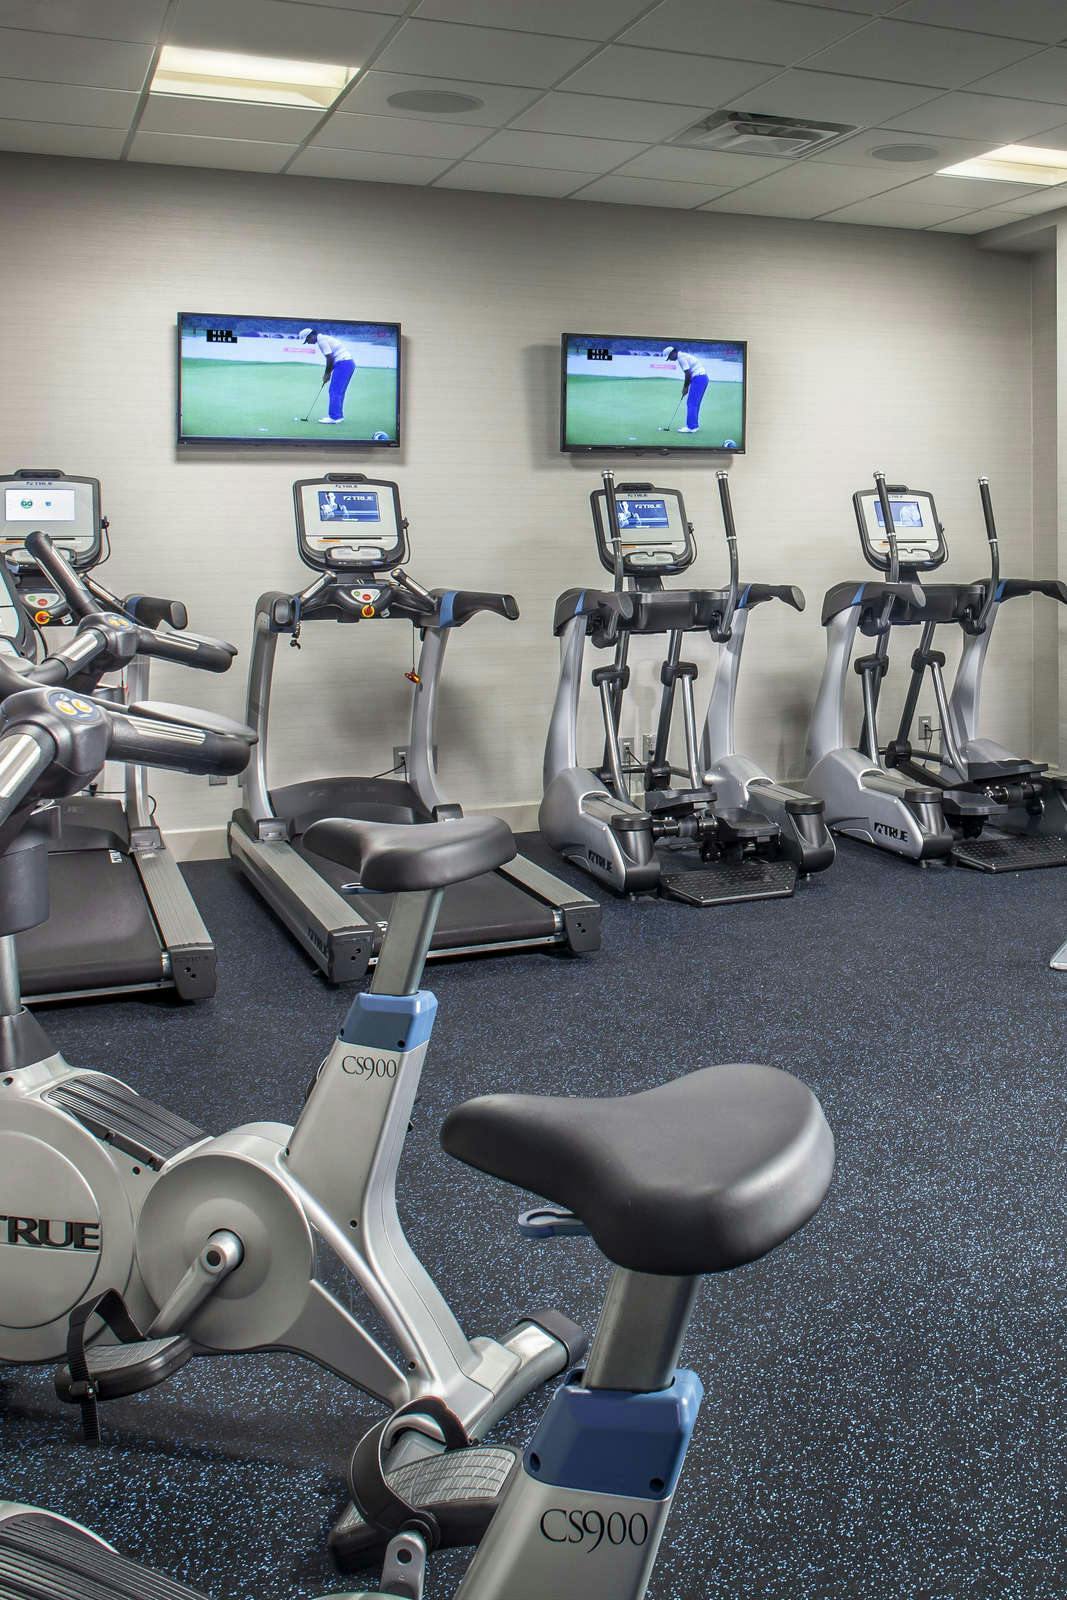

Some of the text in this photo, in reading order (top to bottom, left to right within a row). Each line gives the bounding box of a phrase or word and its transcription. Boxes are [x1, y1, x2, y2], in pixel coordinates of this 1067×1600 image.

[881, 823, 908, 842] TRUE
[342, 1055, 397, 1081] CS900
[540, 1508, 648, 1554] CS900
